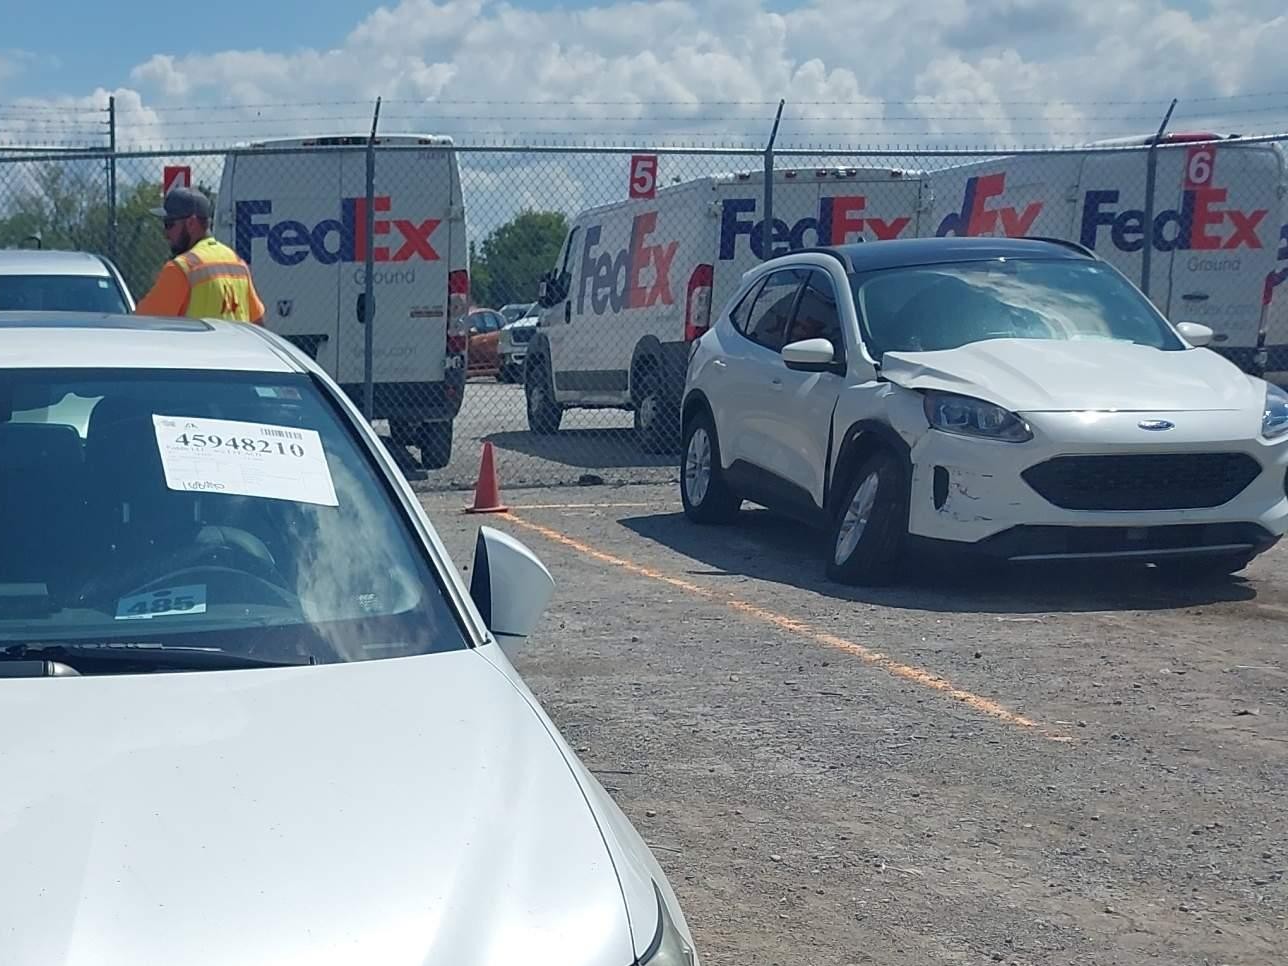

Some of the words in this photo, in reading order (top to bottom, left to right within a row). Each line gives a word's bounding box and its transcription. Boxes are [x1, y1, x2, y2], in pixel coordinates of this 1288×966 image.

[632, 160, 654, 194] 5
[1189, 151, 1211, 184] 6
[235, 196, 441, 266] FedEx
[1081, 187, 1269, 251] FedEx
[354, 268, 416, 287] Gound
[576, 211, 680, 316] FedEx
[1187, 256, 1241, 272] Ground
[175, 433, 305, 458] 45948210
